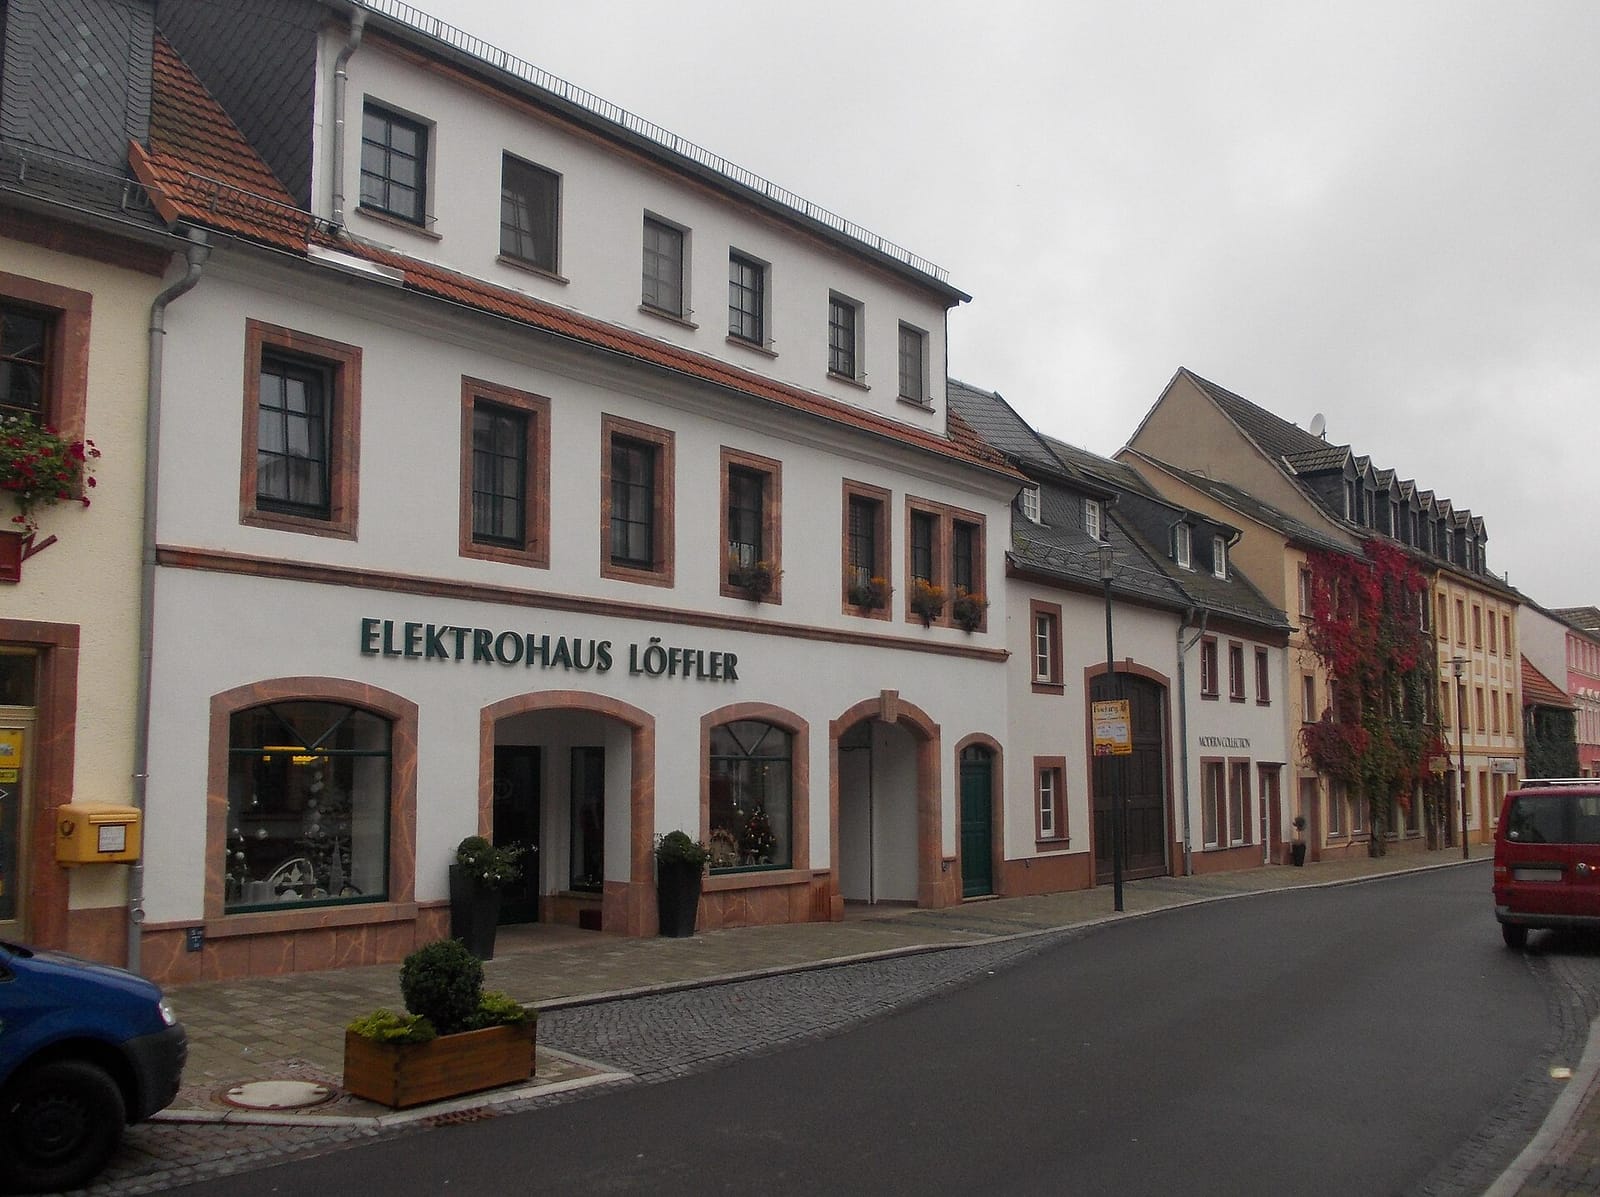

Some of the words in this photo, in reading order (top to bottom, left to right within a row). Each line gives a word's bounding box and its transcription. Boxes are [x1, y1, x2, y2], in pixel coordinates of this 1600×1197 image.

[360, 617, 613, 672] ELEKTROHAUS
[628, 636, 740, 681] LÖFFLER
[1198, 736, 1221, 748] MODERN
[1221, 737, 1251, 749] COLLECTION
